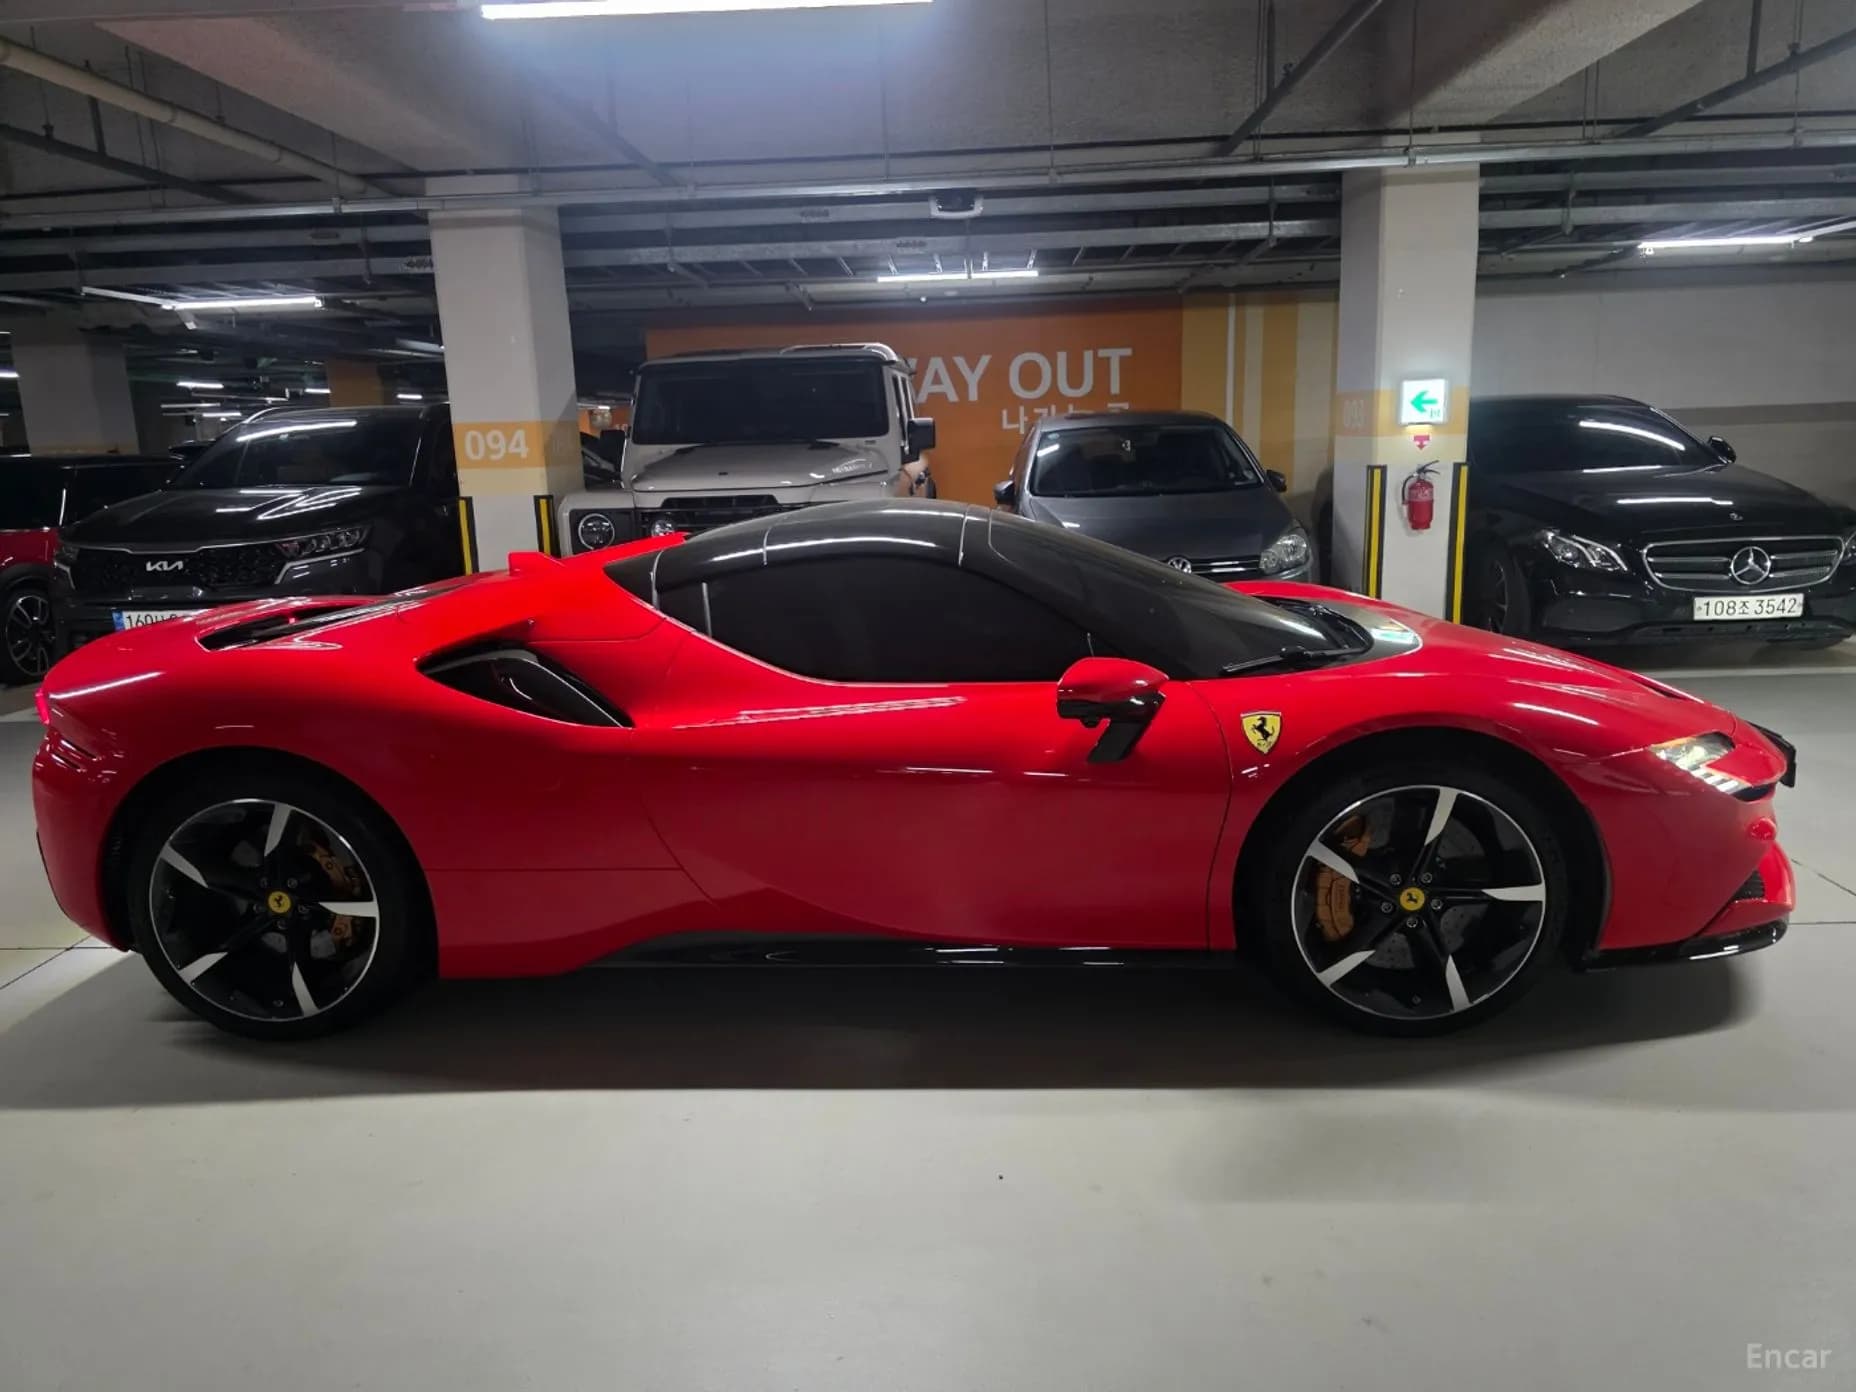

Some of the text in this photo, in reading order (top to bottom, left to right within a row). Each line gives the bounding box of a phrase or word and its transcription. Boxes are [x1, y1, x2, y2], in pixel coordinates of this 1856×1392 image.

[1008, 347, 1133, 399] OUT
[464, 429, 530, 462] 094
[1704, 597, 1797, 617] 108조 3542
